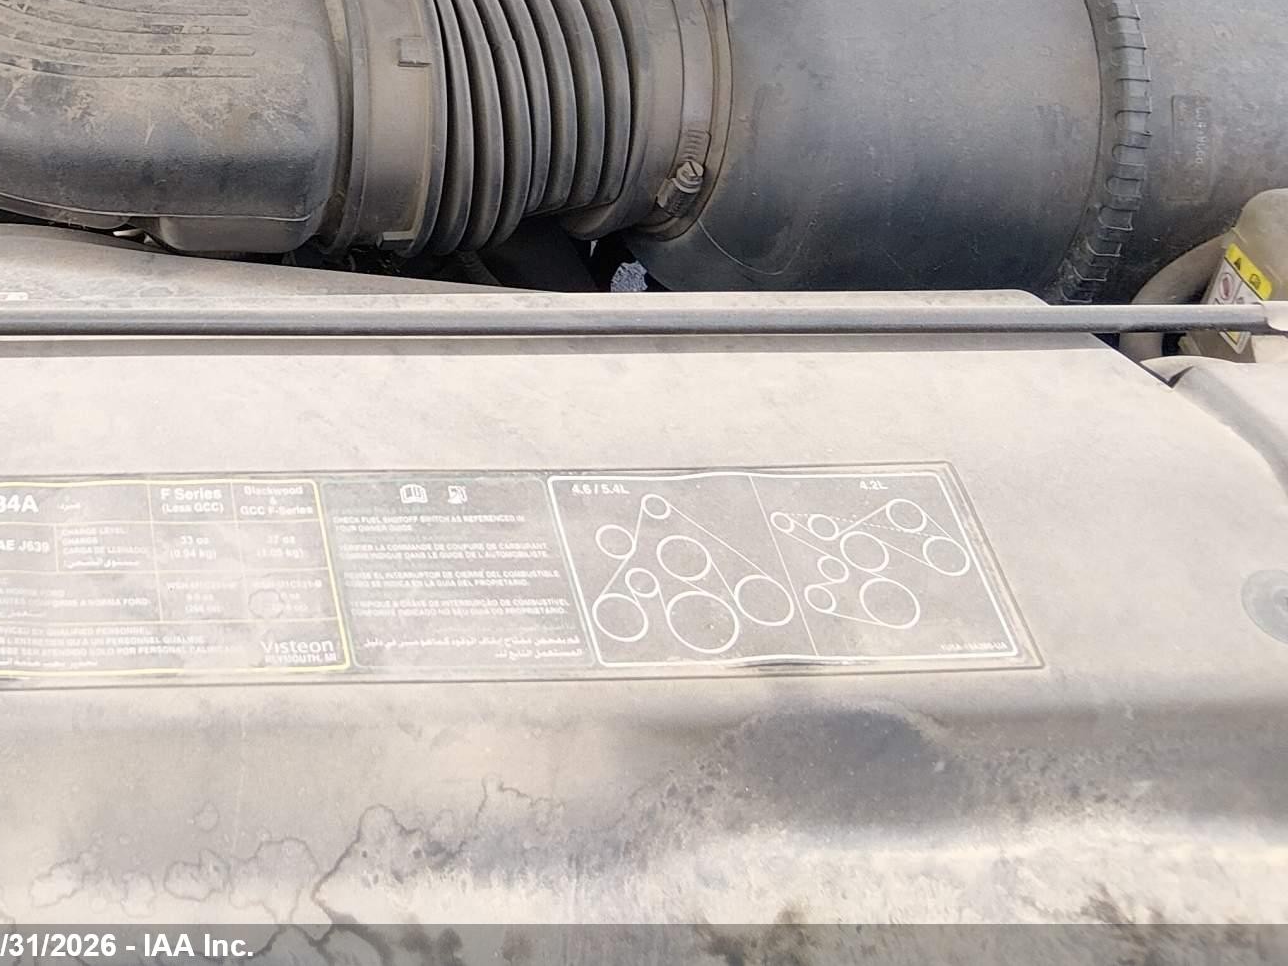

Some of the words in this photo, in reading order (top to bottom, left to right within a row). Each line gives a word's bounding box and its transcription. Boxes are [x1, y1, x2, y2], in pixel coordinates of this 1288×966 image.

[571, 483, 592, 495] 4.6
[602, 484, 630, 496] 5.4L
[859, 480, 889, 491] 4.2L
[160, 489, 171, 502] F
[175, 488, 223, 502] Series
[17, 540, 51, 553] J639
[260, 639, 334, 655] Visteon
